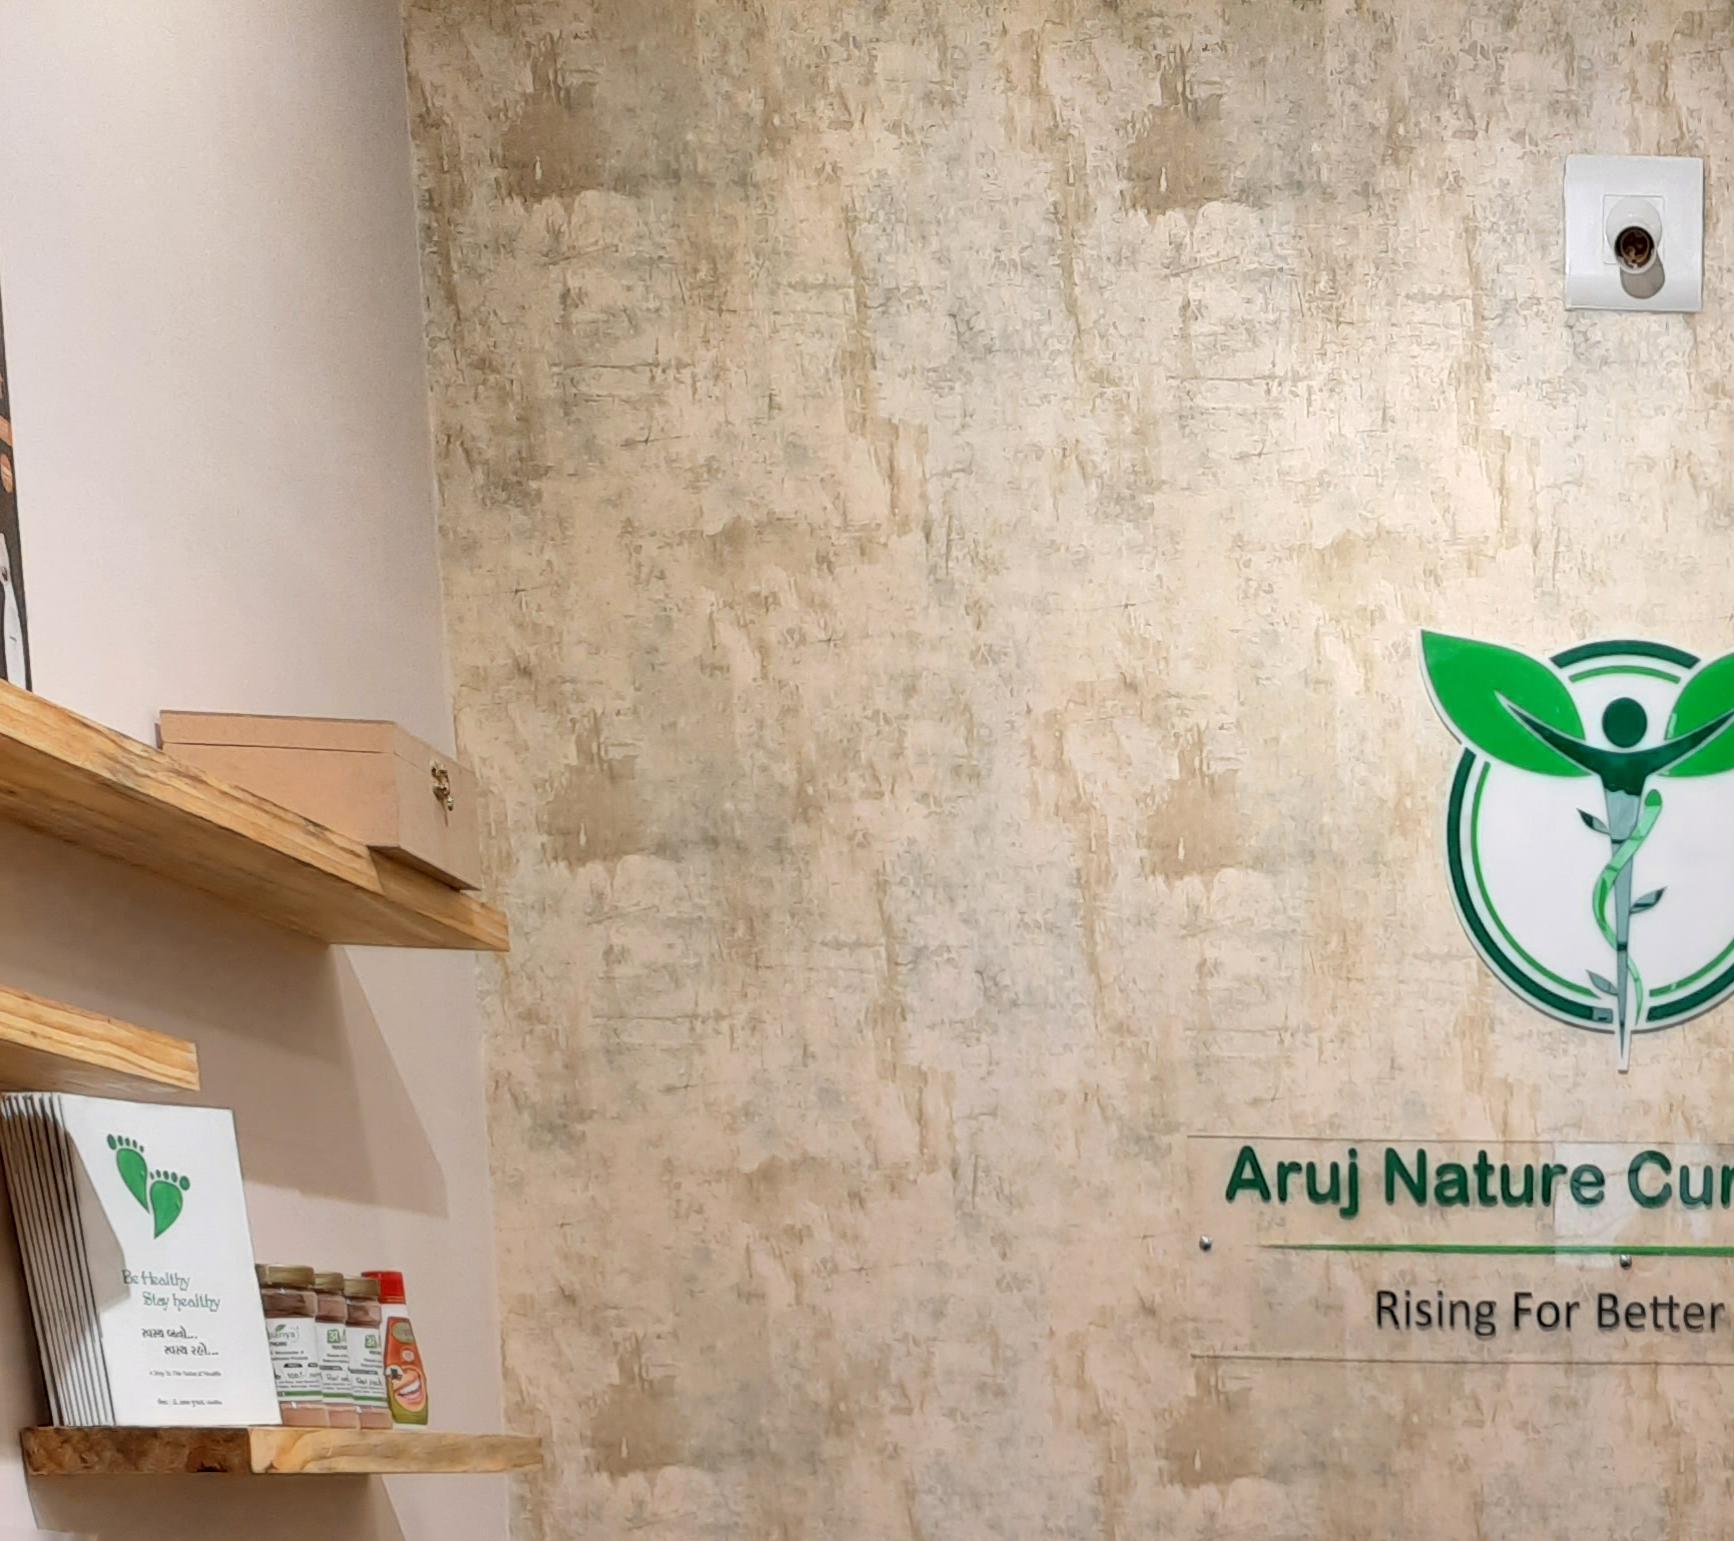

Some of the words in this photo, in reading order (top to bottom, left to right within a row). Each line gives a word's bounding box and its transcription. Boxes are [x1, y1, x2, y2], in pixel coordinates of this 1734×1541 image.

[1225, 1146, 1359, 1220] Aruj
[1384, 1147, 1606, 1208] Nature
[1376, 1290, 1498, 1337] Rising
[1513, 1291, 1581, 1331] For
[1597, 1292, 1726, 1332] Better
